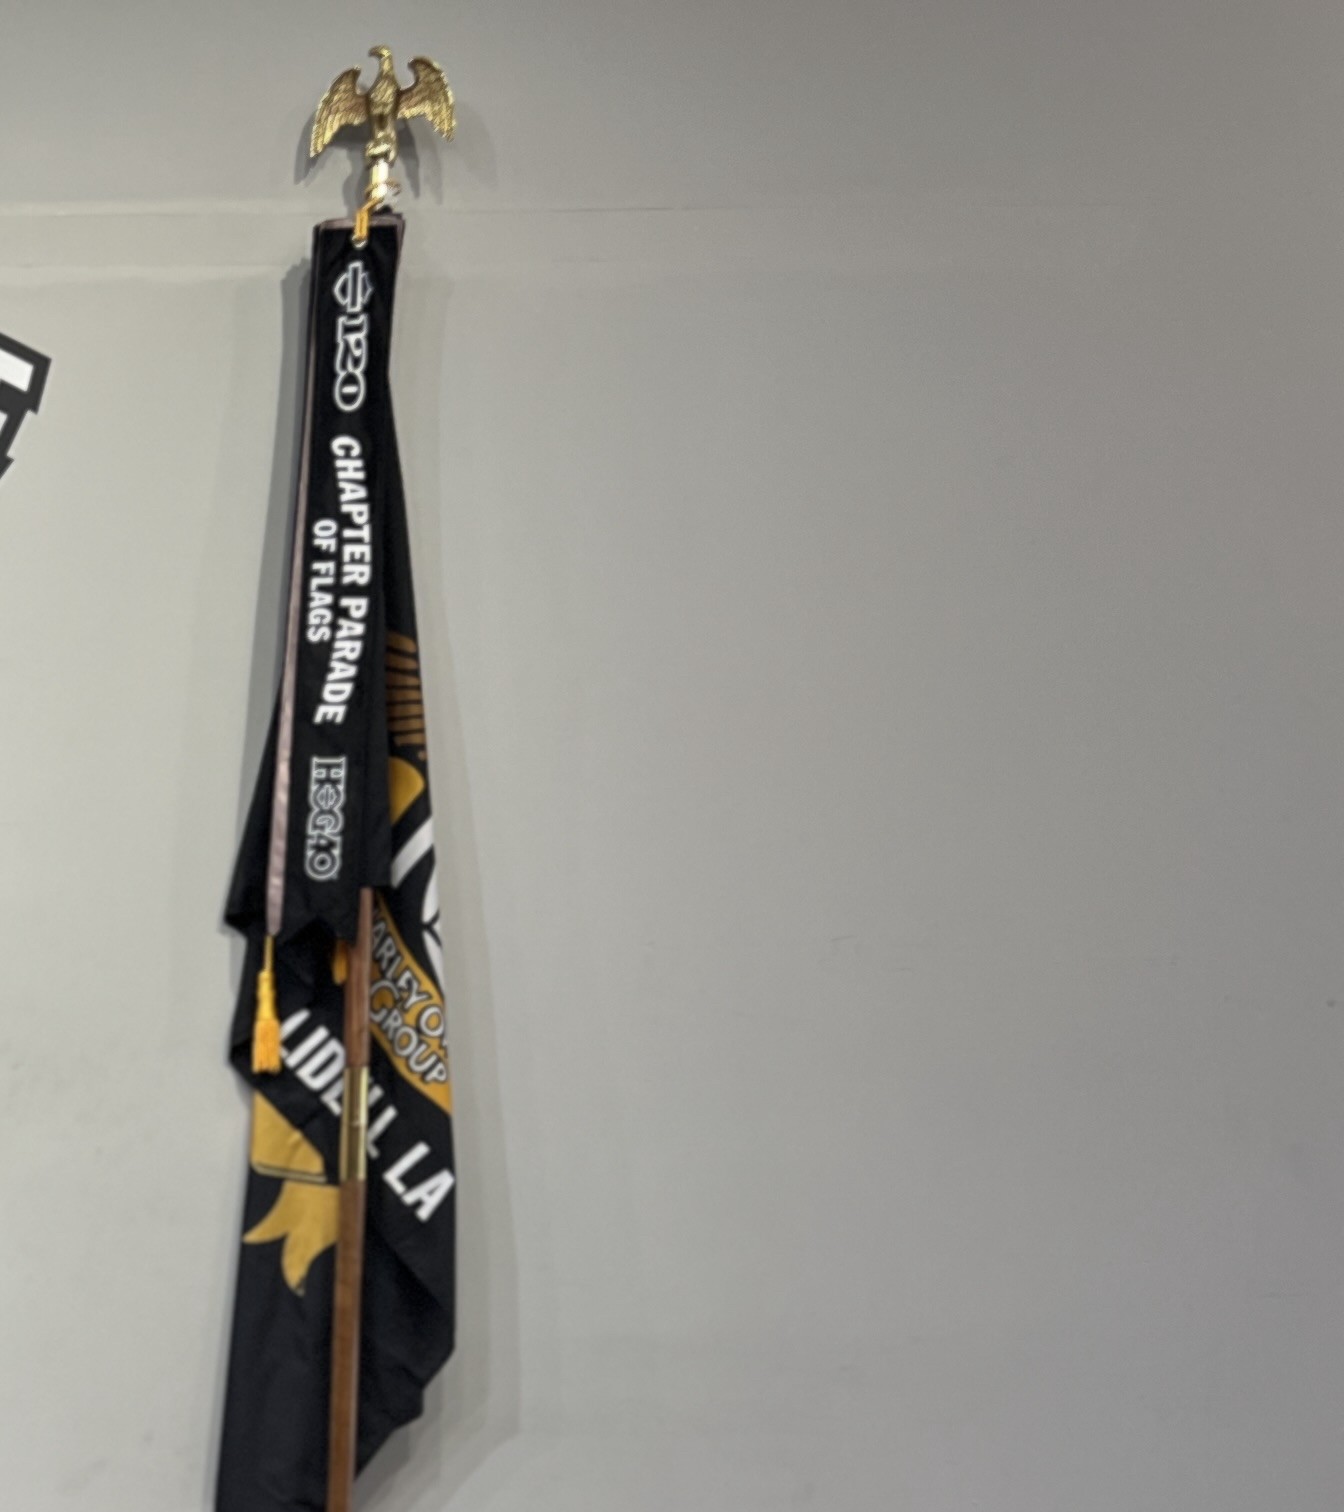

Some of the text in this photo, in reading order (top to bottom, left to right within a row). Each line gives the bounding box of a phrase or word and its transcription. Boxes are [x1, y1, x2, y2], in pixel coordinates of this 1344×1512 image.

[306, 518, 337, 644] OF FLAGS
[313, 435, 371, 724] CHAPTER PARADE
[370, 979, 448, 1083] GROUP
[382, 1140, 455, 1222] LA
